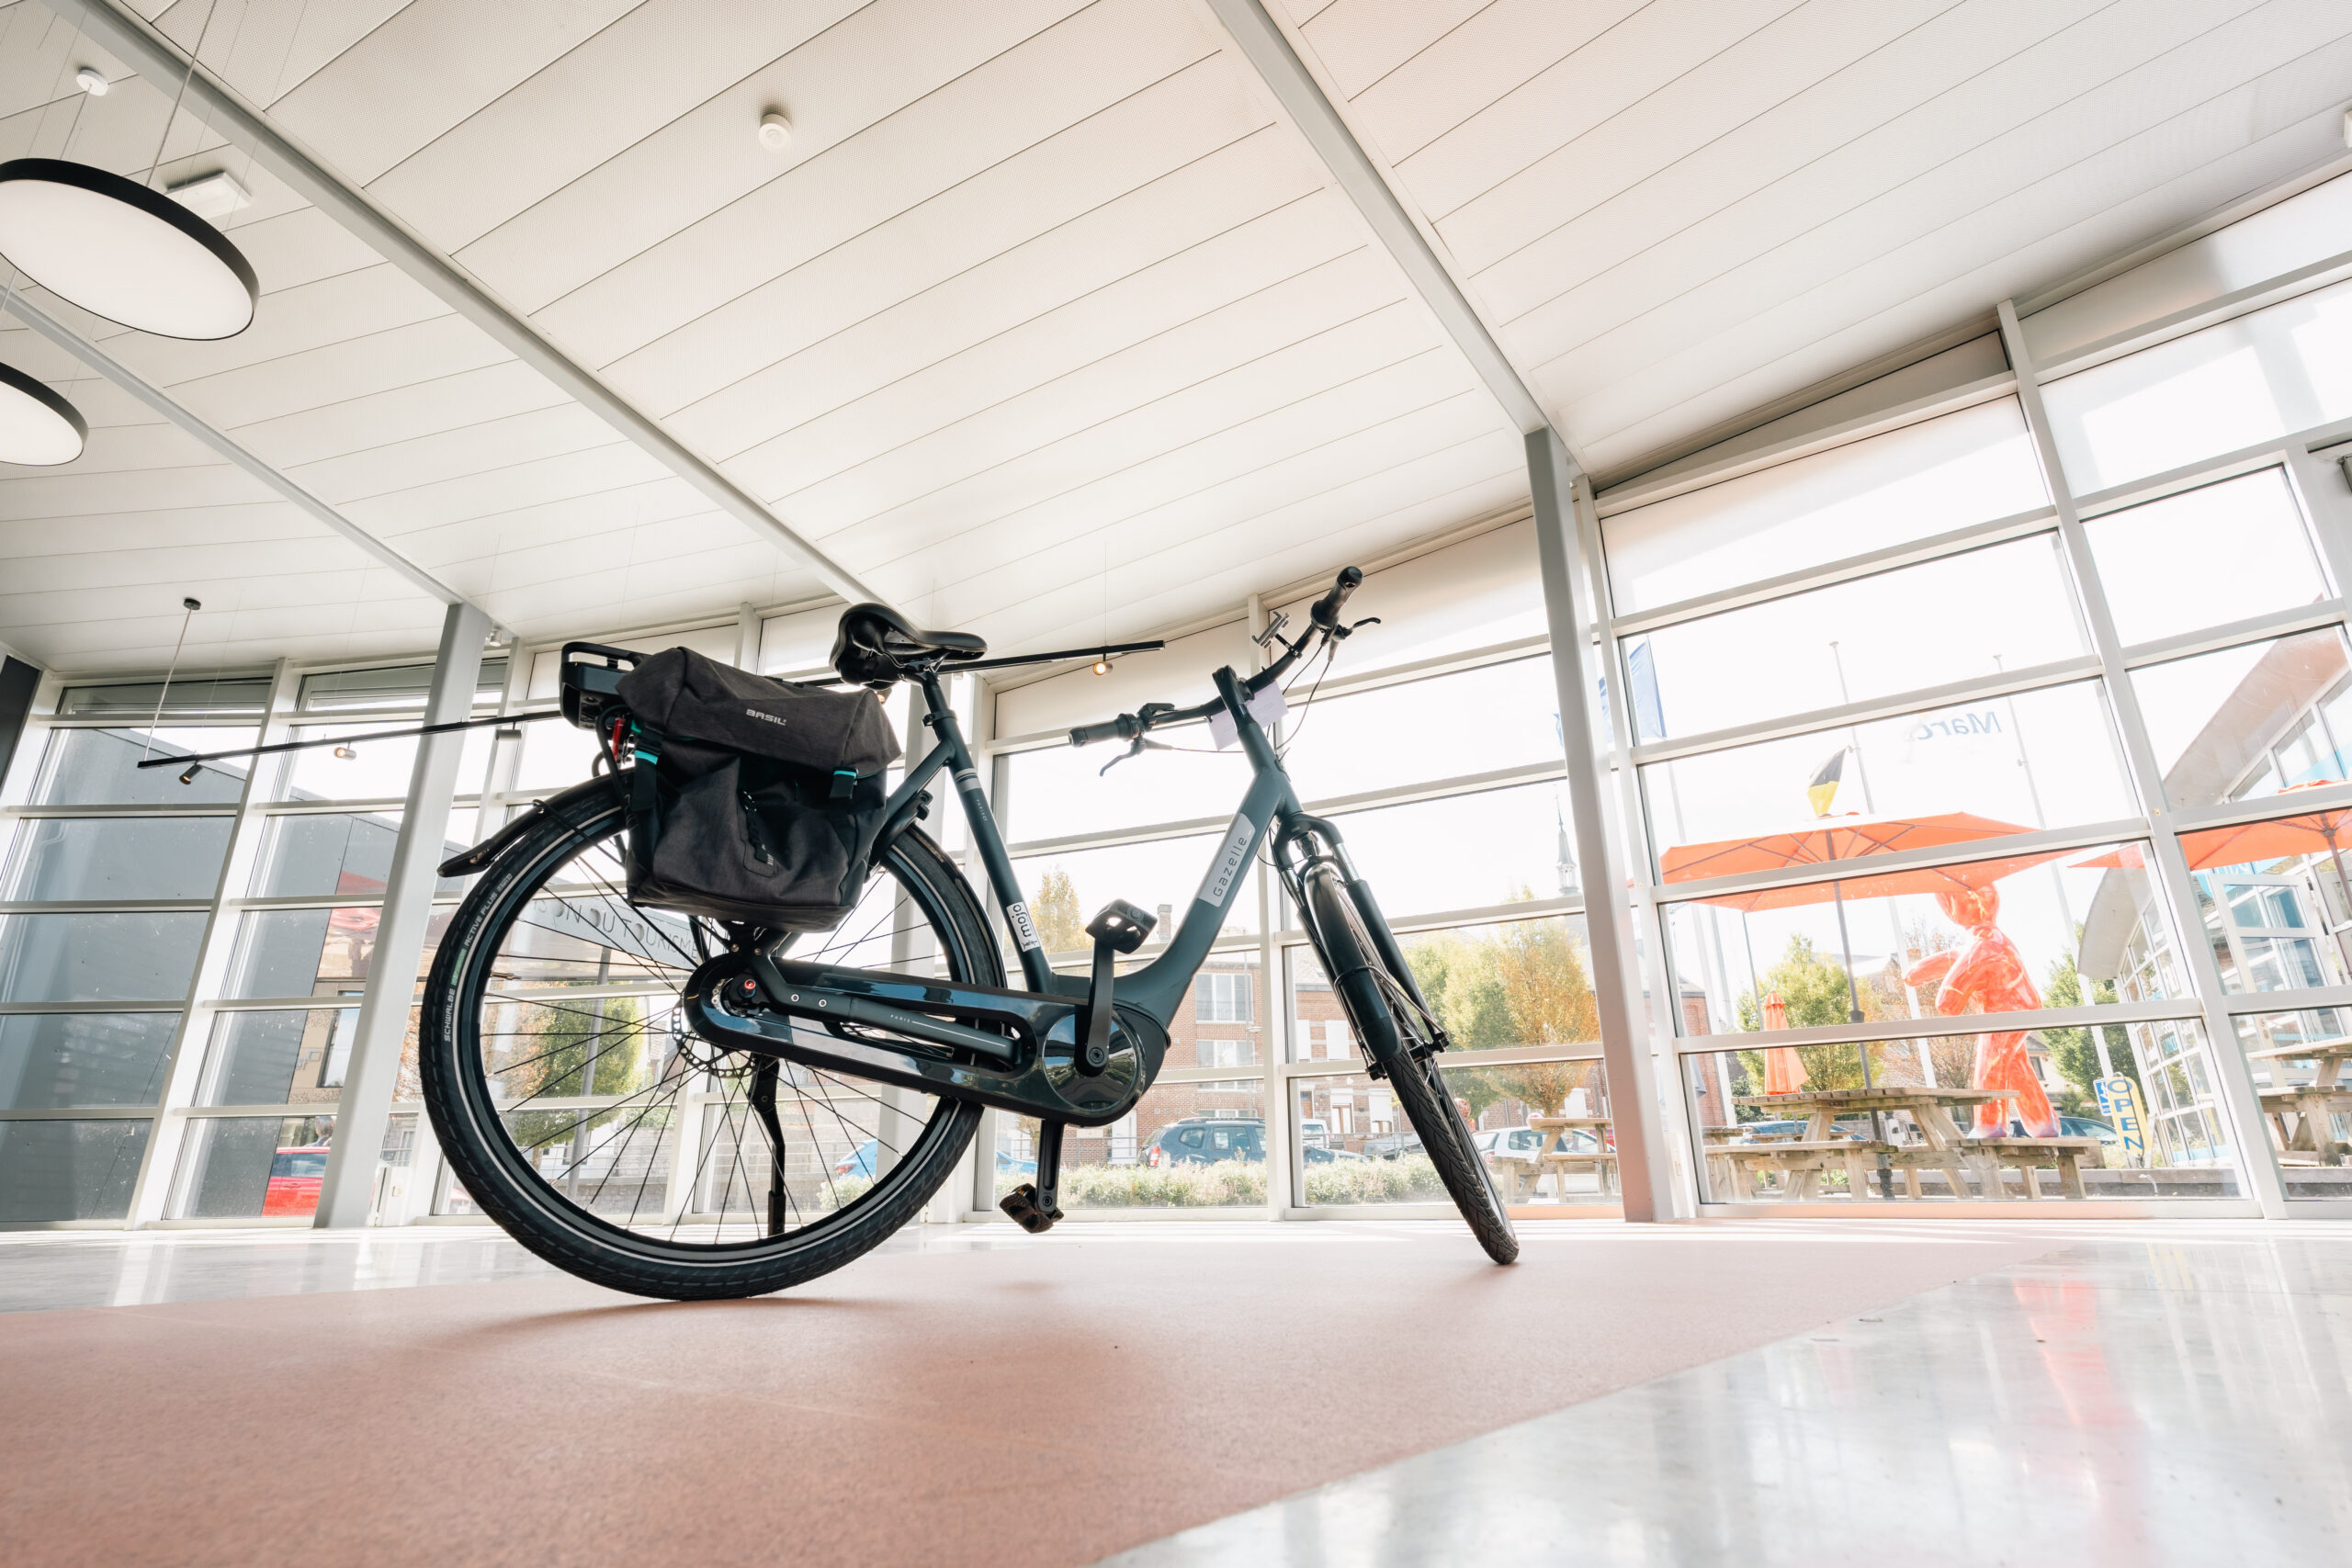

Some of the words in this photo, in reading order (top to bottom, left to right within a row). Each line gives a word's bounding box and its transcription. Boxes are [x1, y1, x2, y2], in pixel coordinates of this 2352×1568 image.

[746, 708, 786, 726] BASIL
[1213, 836, 1247, 897] Gazelle
[1011, 903, 1033, 939] mojo
[444, 987, 456, 1043] SCHWALBE
[464, 913, 482, 947] ACTIVE
[481, 892, 498, 915] PLUS
[2108, 1079, 2144, 1151] OPEN
